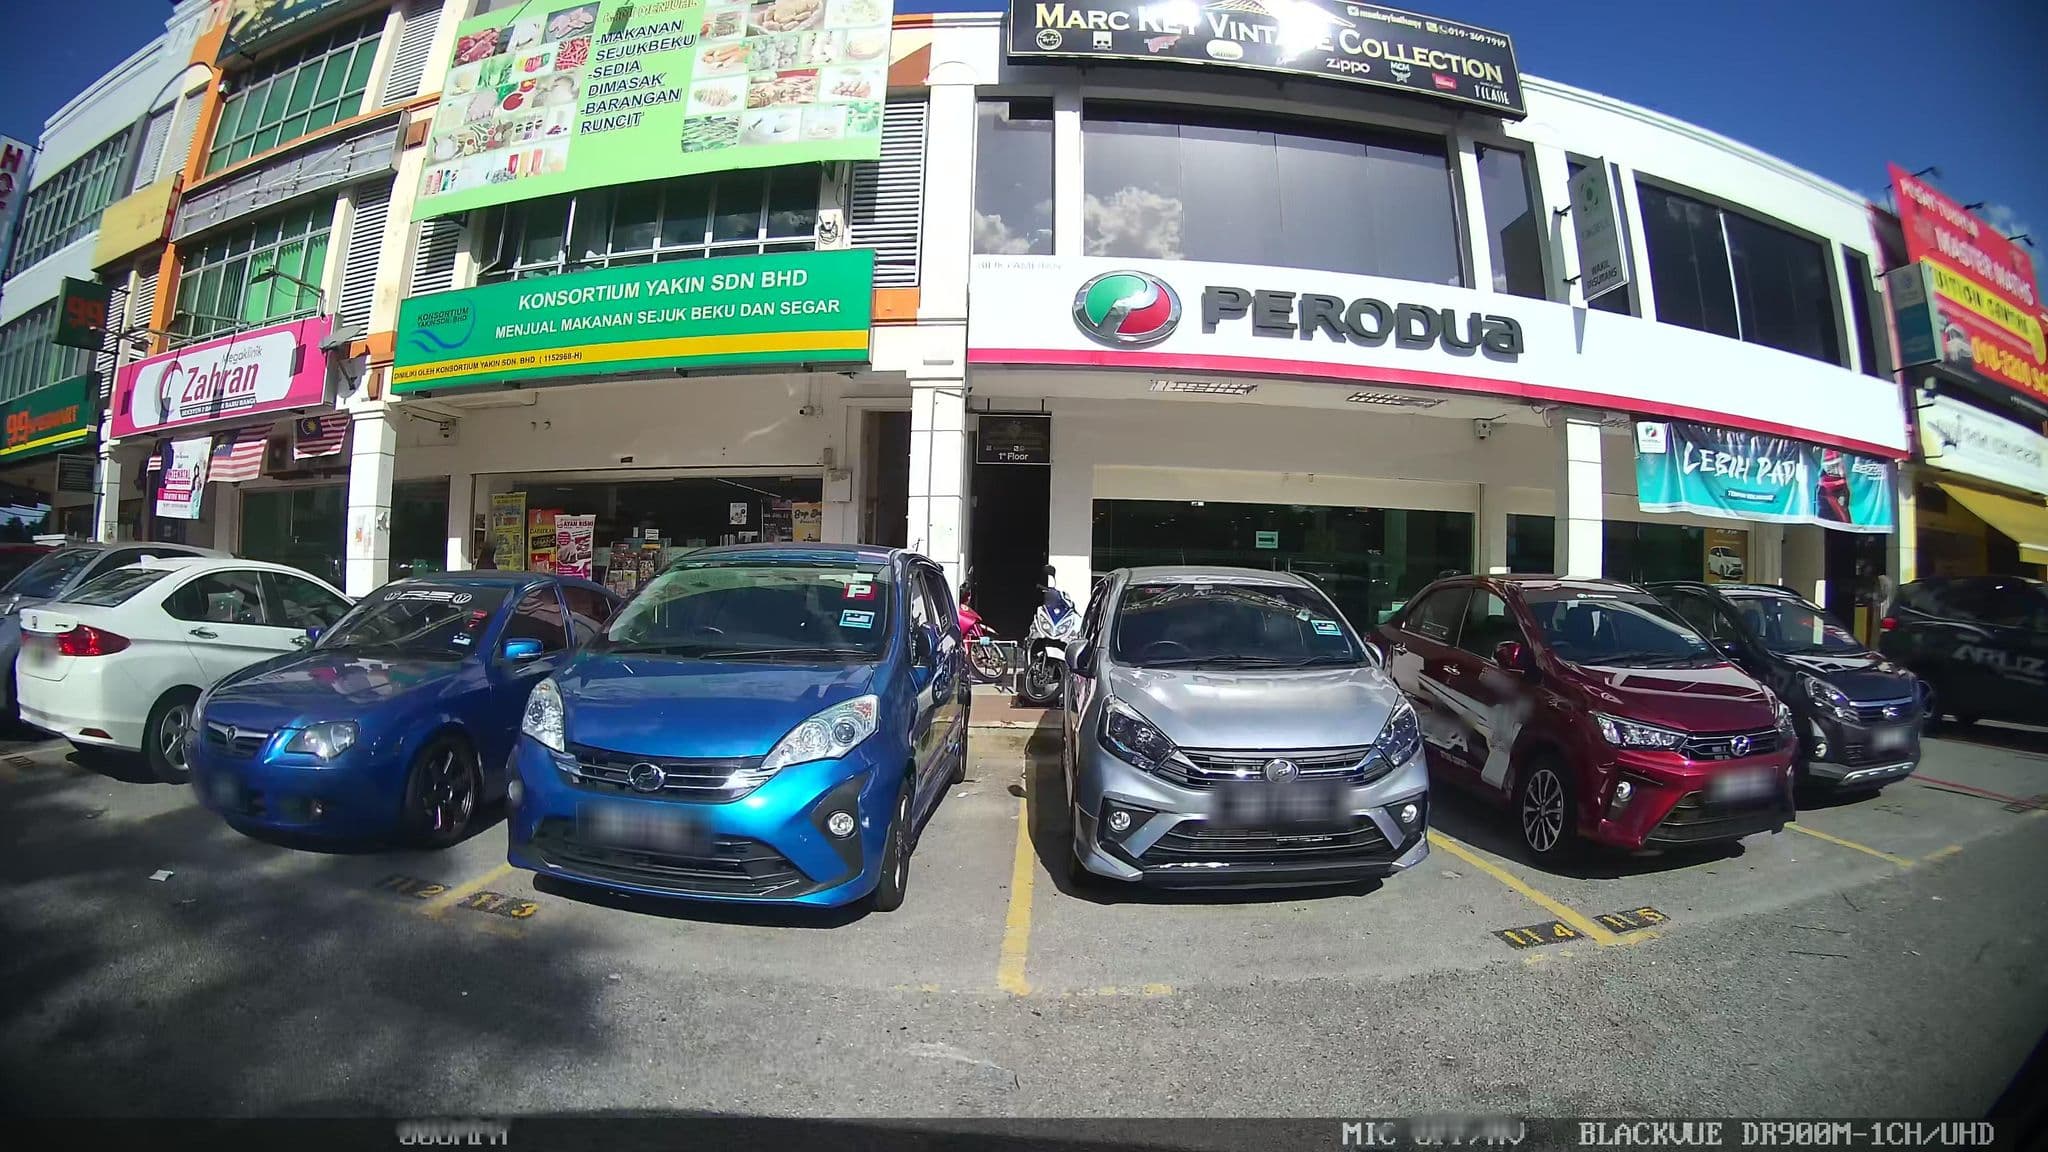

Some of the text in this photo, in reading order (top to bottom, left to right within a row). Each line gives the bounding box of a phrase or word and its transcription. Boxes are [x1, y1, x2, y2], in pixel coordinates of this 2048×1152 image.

[596, 35, 696, 61] SEJUKBEKU
[1035, 3, 1130, 30] MARC
[1339, 28, 1504, 84] COLLECTION
[588, 73, 666, 97] DIMASAK
[580, 112, 644, 135] RUNCIT
[518, 269, 808, 311] KONSORTIUM YAKIN SDN BHD
[417, 307, 469, 322] KONSORTIUM
[495, 298, 840, 340] MENJUAL MAKANAN SEJUK BEKU DAN SEGAR
[436, 362, 479, 375] KONSORTIUM
[480, 360, 500, 371] YAKIN
[520, 356, 536, 366] BHD
[181, 362, 259, 403] Zahran
[1007, 452, 1029, 461] Floor
[1682, 441, 1750, 484] LEBIH
[847, 584, 871, 597] P
